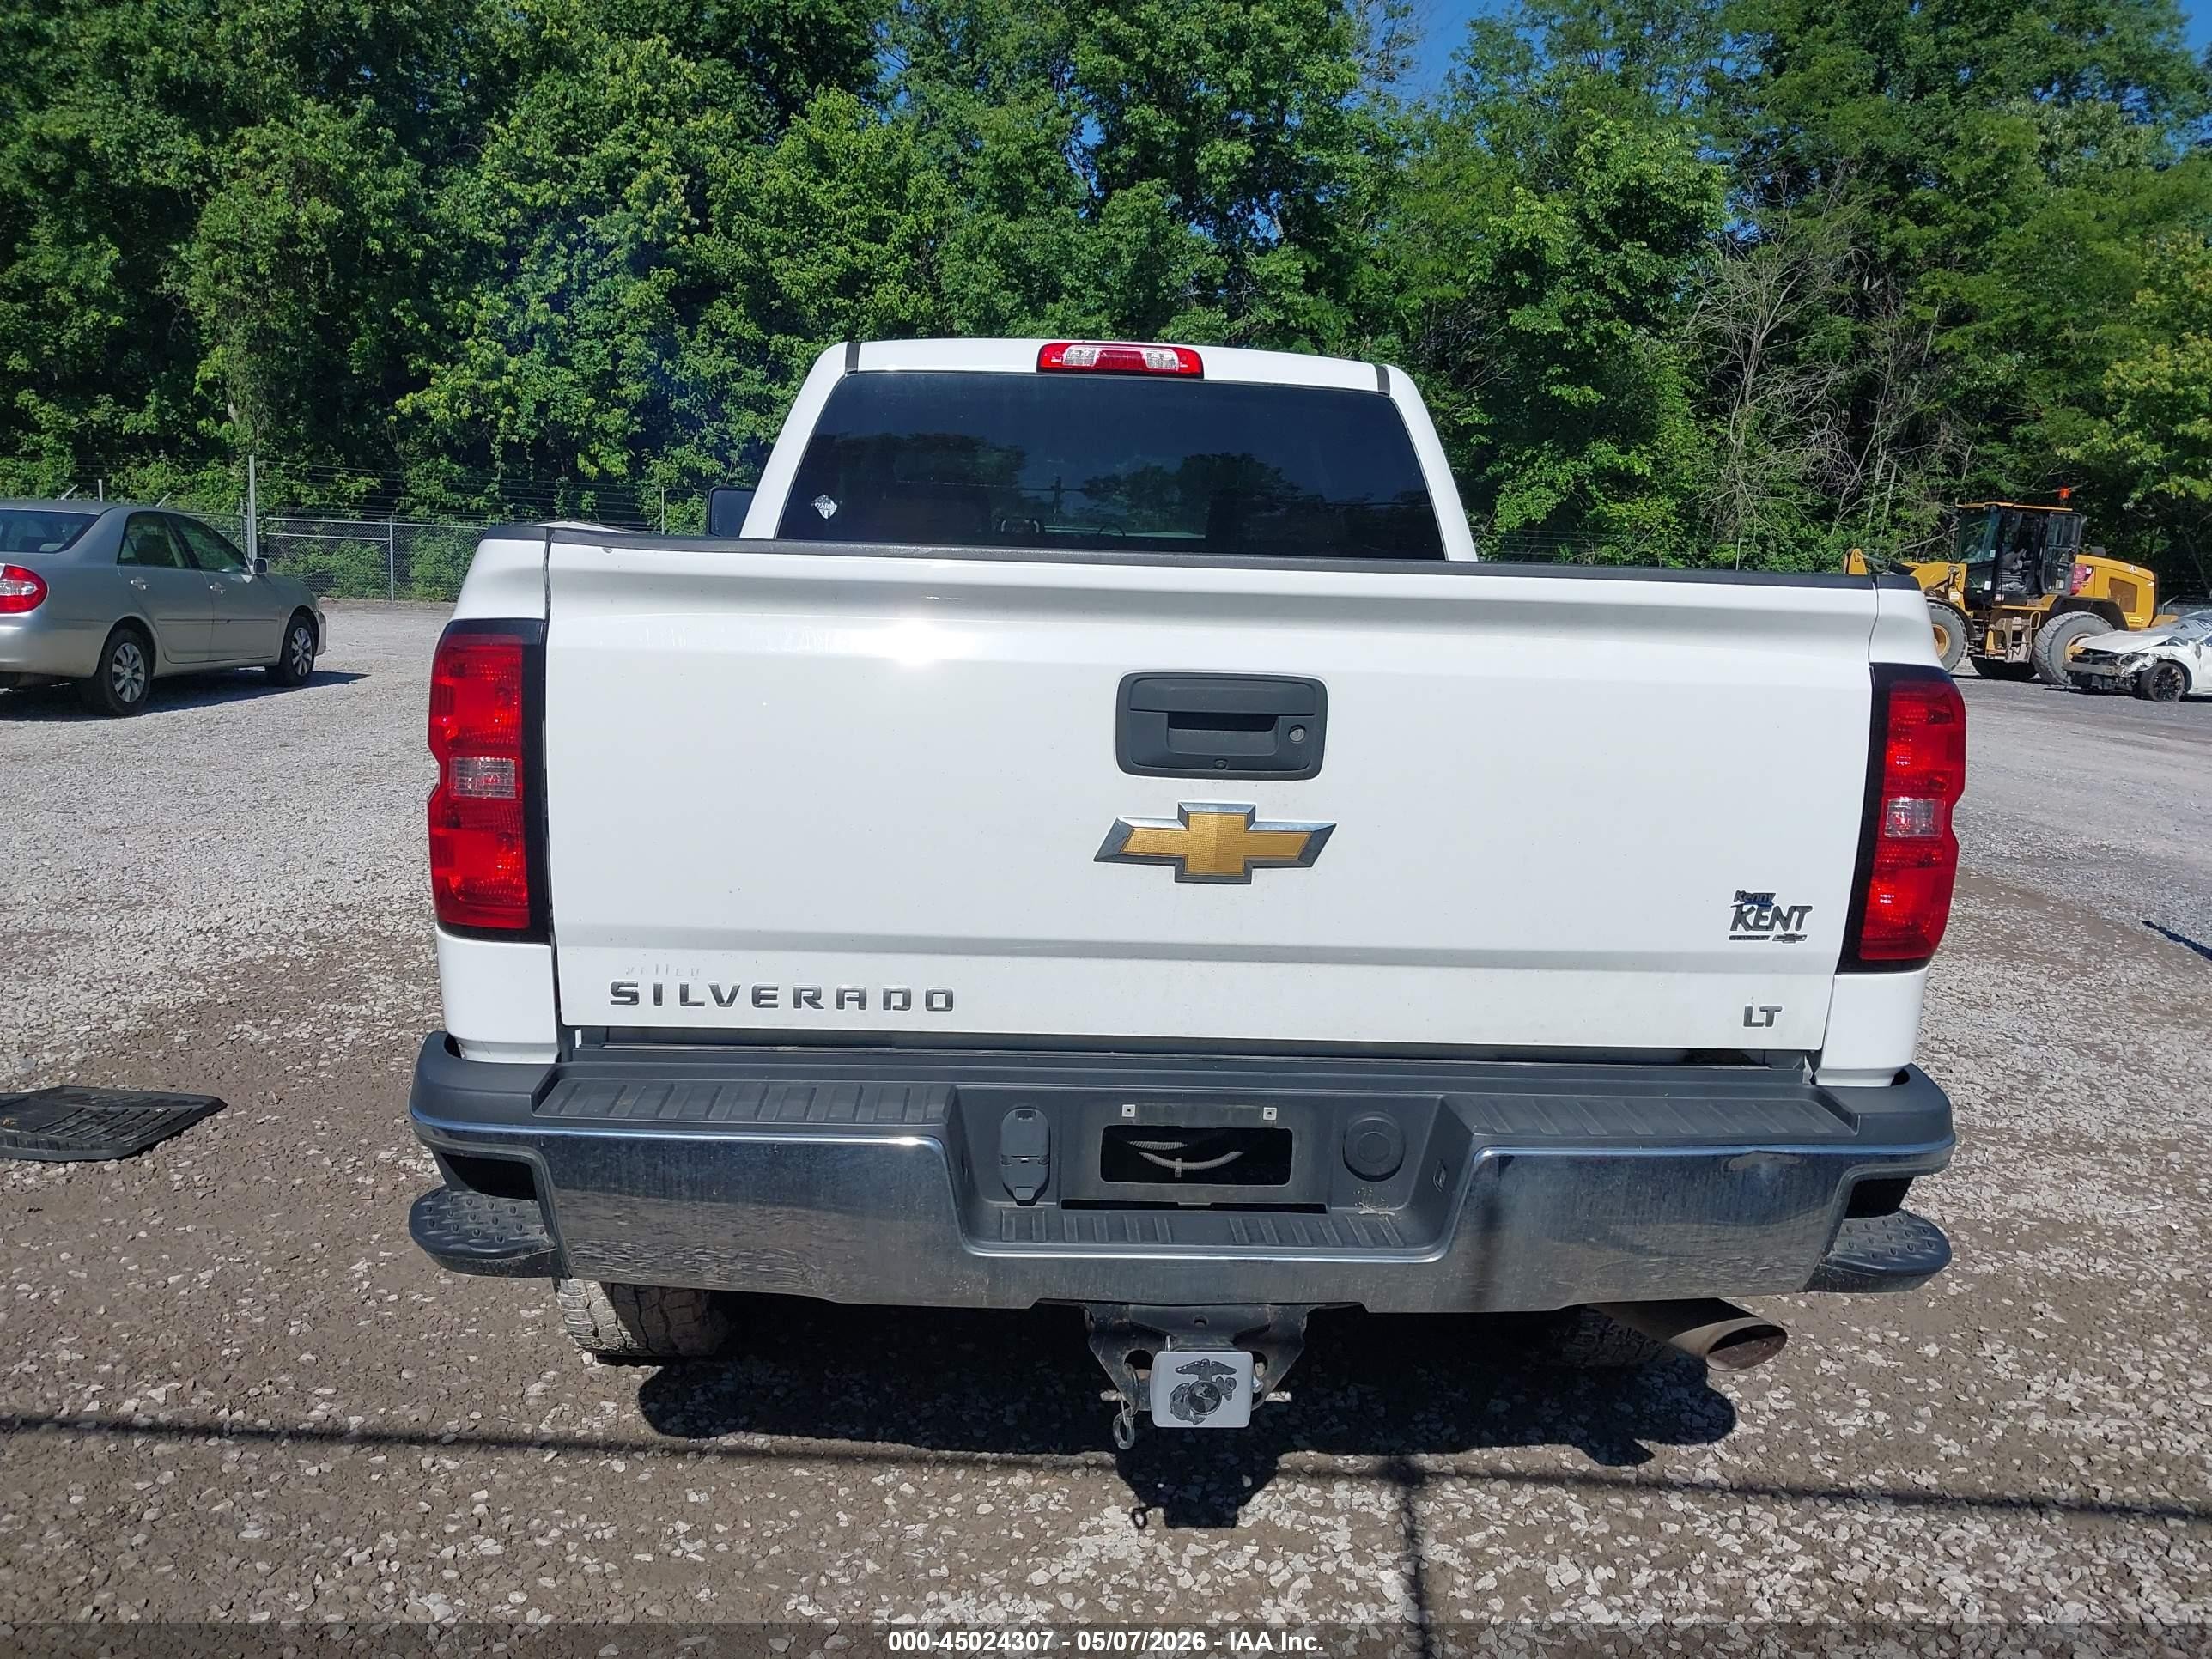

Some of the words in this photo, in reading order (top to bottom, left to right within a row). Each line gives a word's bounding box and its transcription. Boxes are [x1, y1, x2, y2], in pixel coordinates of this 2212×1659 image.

[1733, 890, 1777, 903] Kenny
[1729, 904, 1814, 932] KENT
[609, 981, 955, 1012] SILVERADO
[1743, 1006, 1783, 1028] LT
